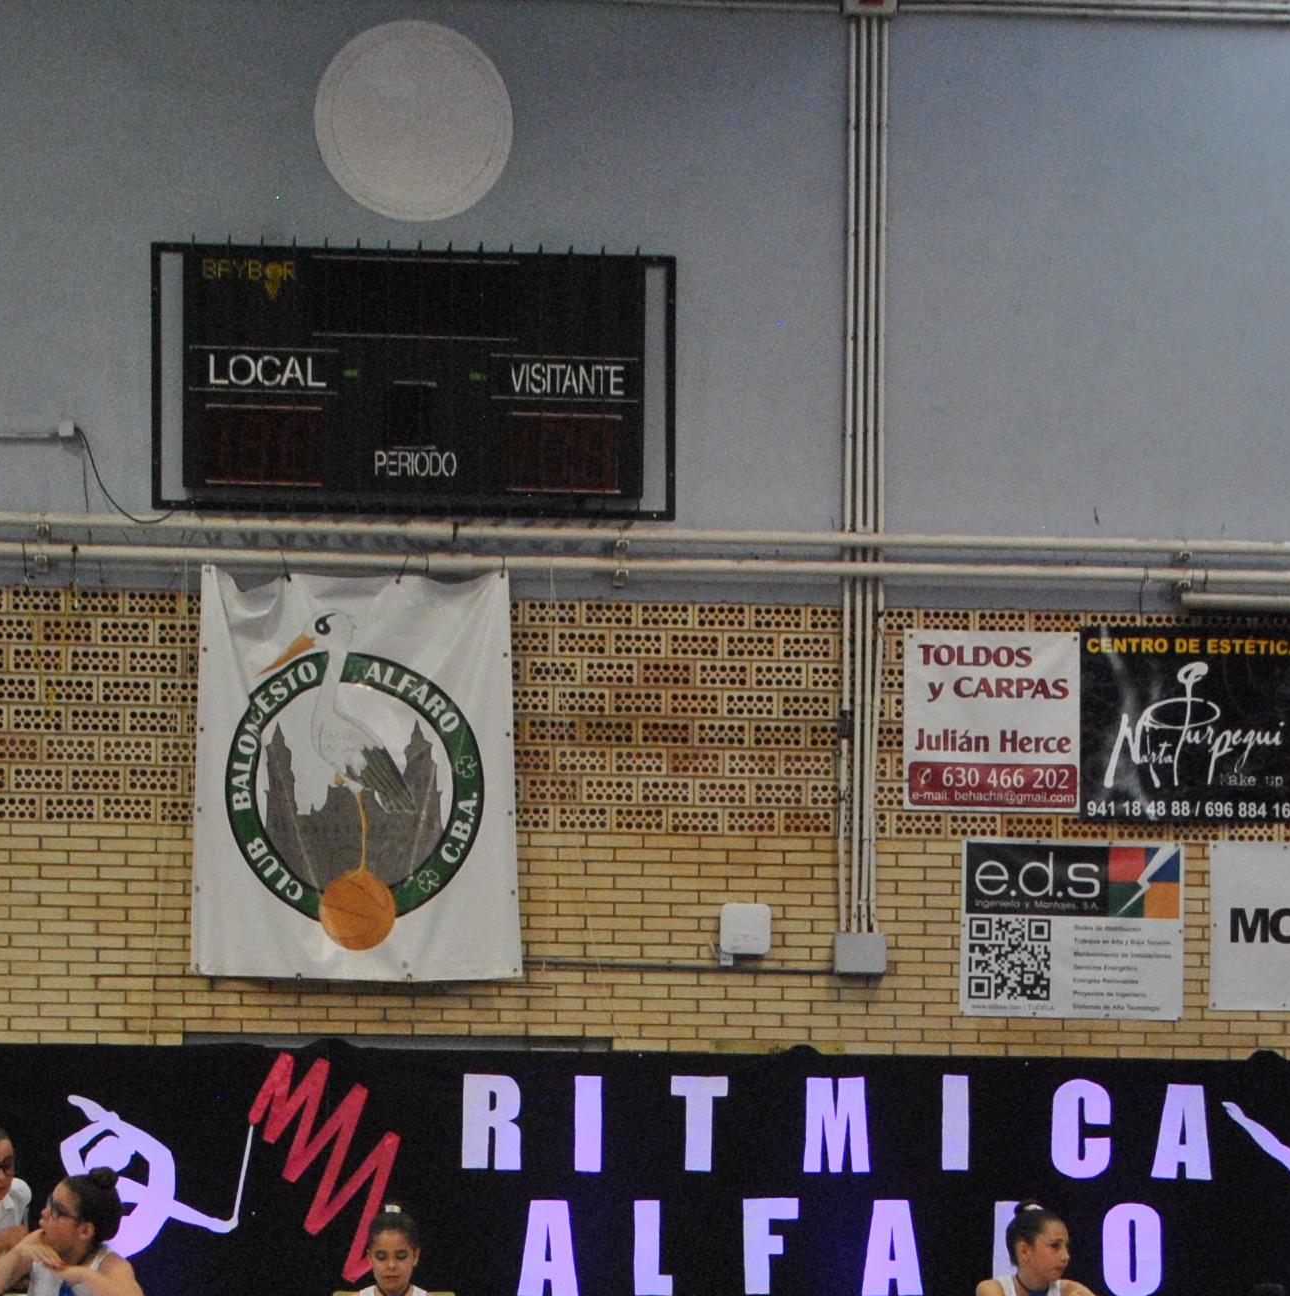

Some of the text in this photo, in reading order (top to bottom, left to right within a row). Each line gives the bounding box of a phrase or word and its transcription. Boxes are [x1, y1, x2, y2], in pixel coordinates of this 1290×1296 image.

[209, 354, 326, 388] LOCAL
[511, 364, 624, 396] VISITANTE
[374, 450, 457, 477] PERIODO
[917, 644, 1032, 668] TOLDOS
[1086, 637, 1168, 655] CENTRO
[1174, 638, 1201, 655] DE
[927, 676, 1070, 702] y CARPAS
[914, 728, 1072, 754] Julián Herce
[232, 661, 460, 901] CLUB BALONCESTO ALFARO
[941, 766, 1070, 789] 630 466 202
[1265, 775, 1284, 788] up
[1087, 801, 1117, 817] 941
[1123, 802, 1143, 817] 18
[1146, 802, 1168, 818] 48
[1170, 802, 1191, 818] 88
[1205, 803, 1235, 818] 696
[1237, 803, 1268, 818] 884
[440, 792, 478, 863] C.B.A.
[974, 851, 1101, 898] e.d.s
[461, 1073, 1213, 1180] RITMICA
